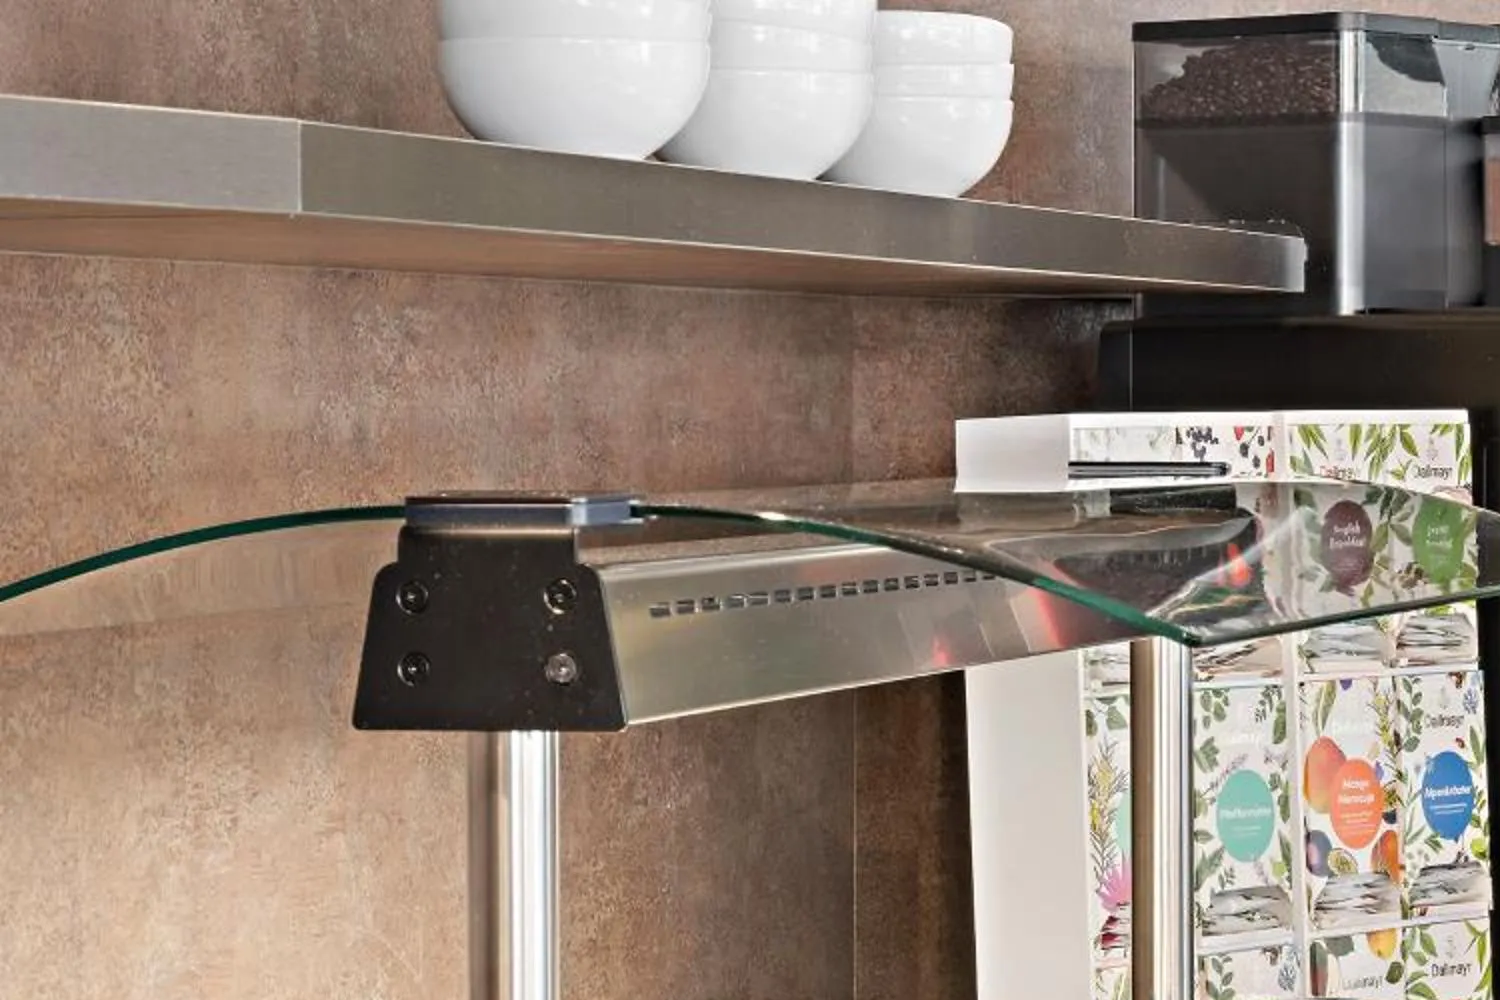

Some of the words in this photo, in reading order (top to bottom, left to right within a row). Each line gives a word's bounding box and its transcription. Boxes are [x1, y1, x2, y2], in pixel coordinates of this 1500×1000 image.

[1414, 464, 1453, 480] Dallmayr
[1425, 714, 1464, 729] Dallmayr
[1431, 962, 1472, 978] Dallmayr
